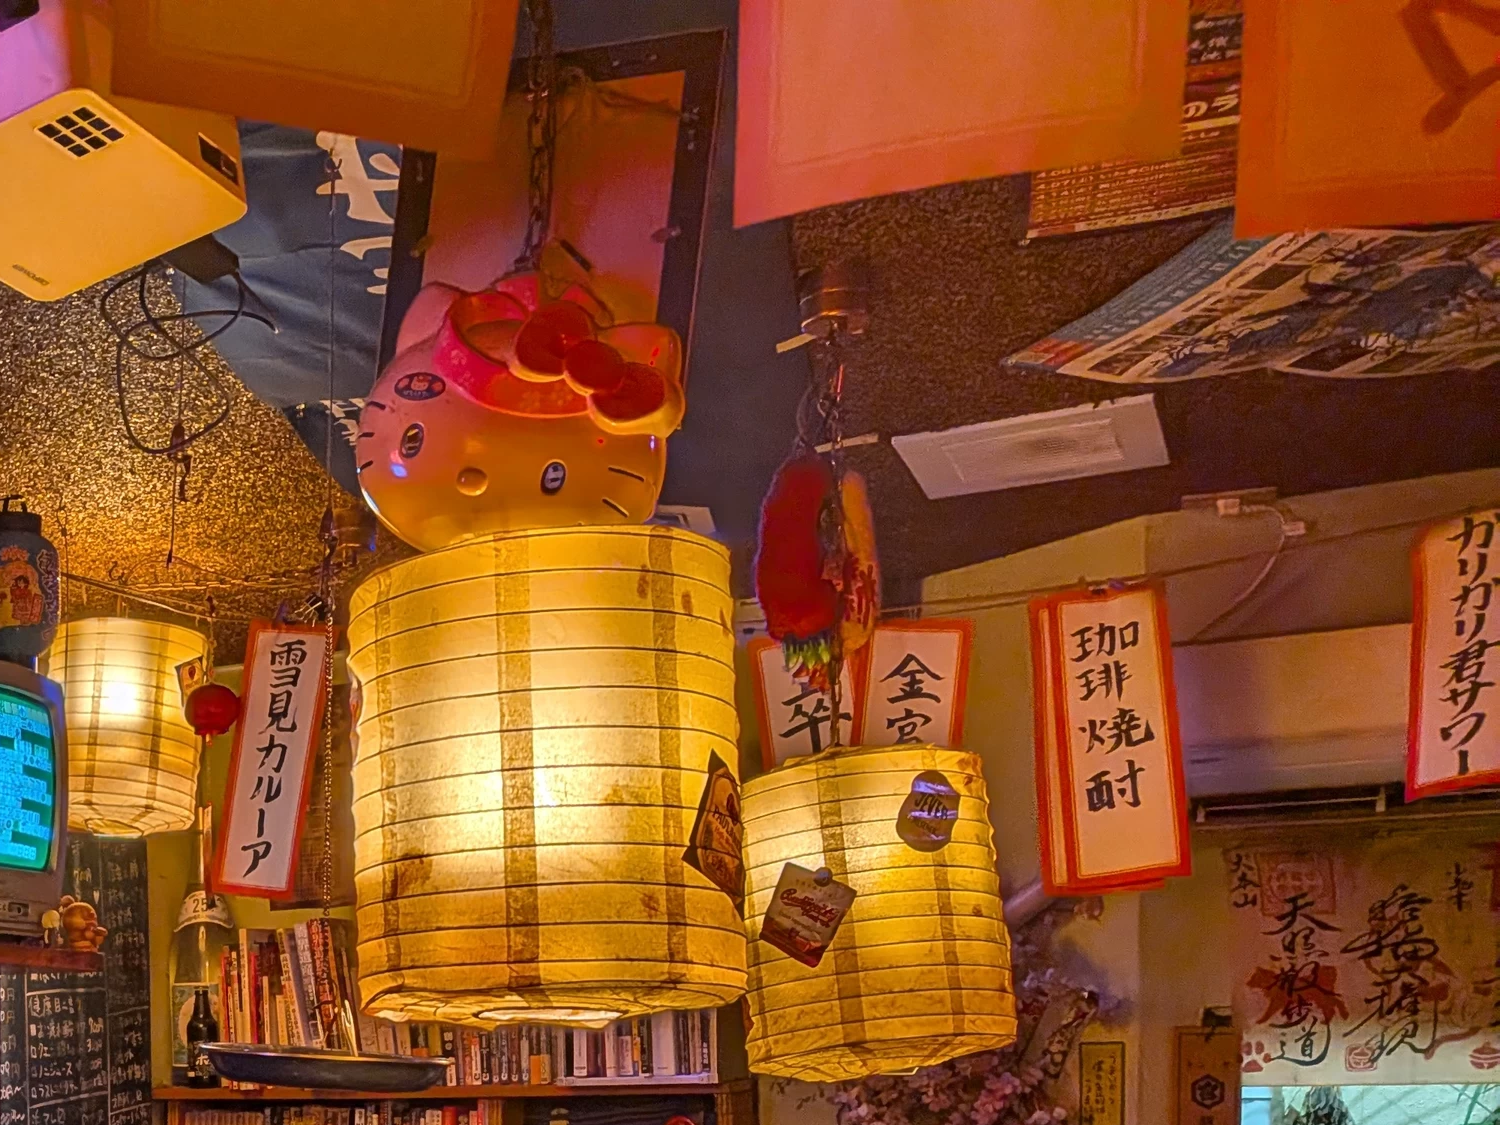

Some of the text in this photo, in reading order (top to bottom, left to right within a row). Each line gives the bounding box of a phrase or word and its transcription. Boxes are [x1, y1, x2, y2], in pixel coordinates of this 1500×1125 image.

[241, 638, 308, 879] 雪見カルーア
